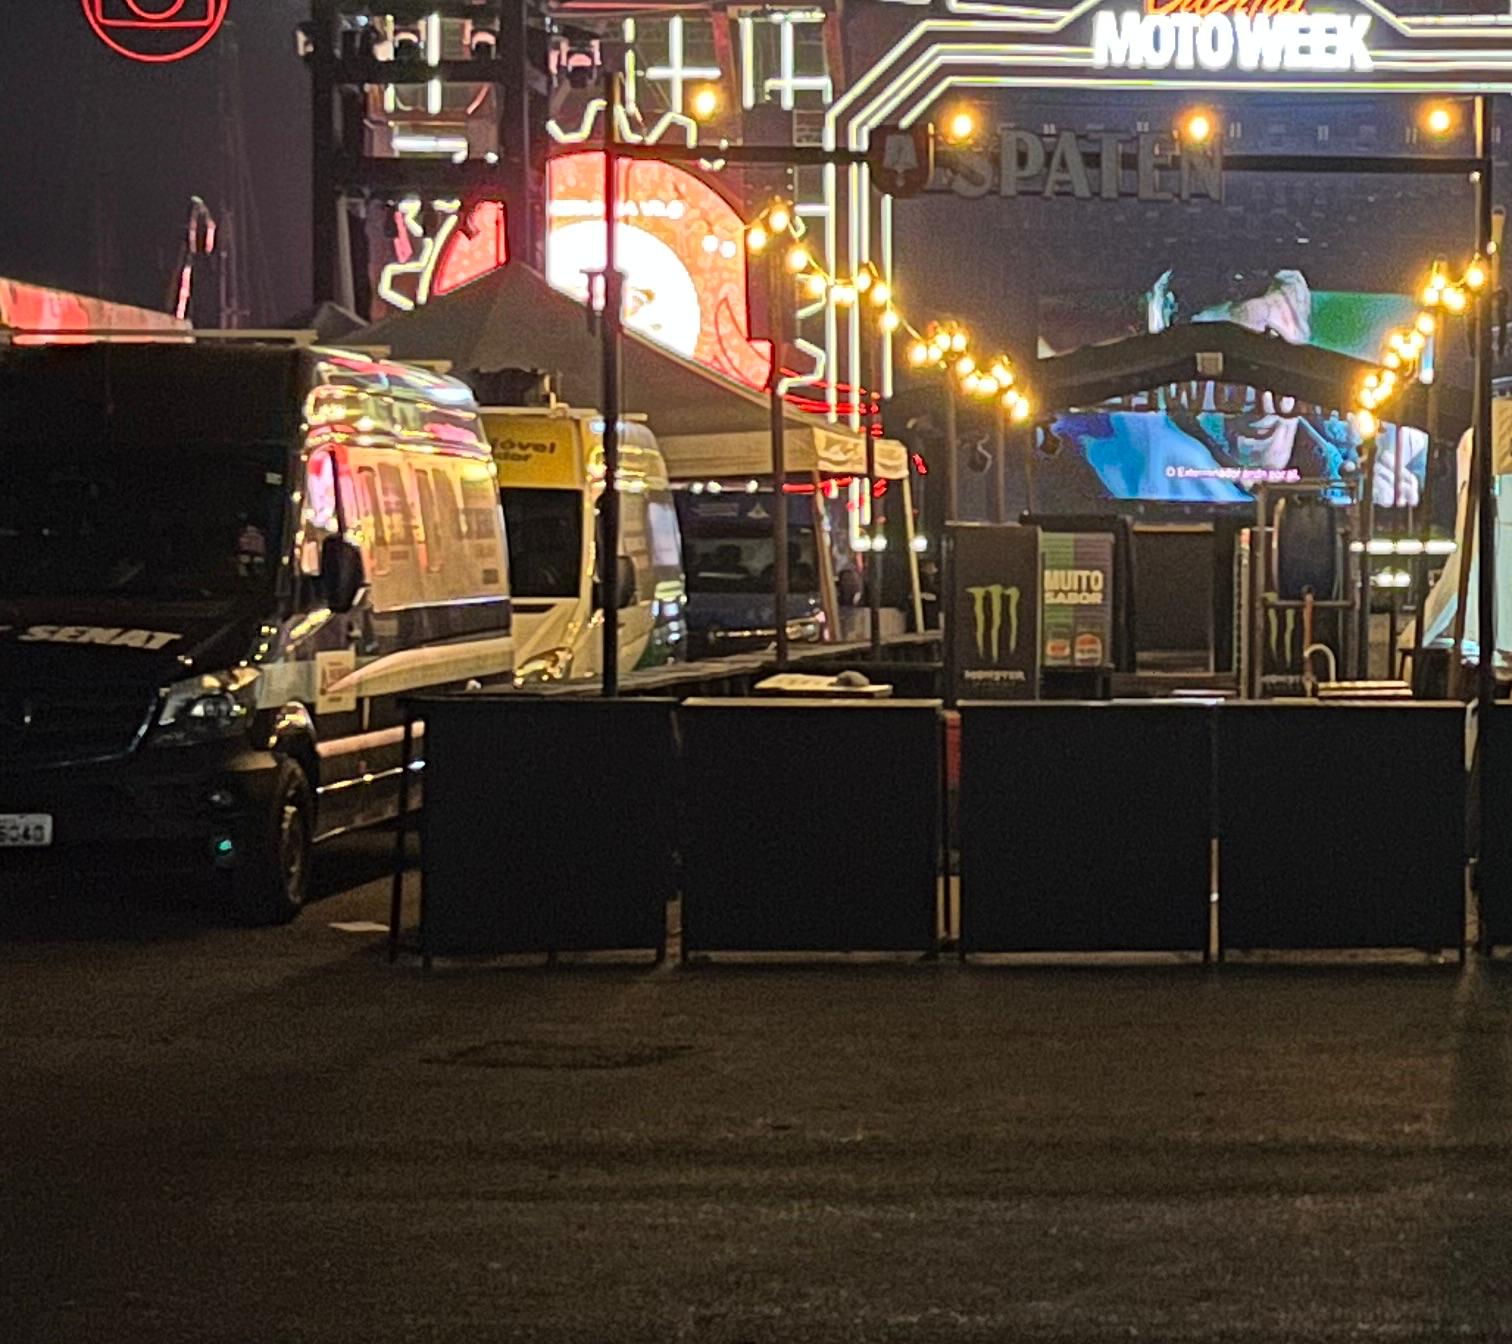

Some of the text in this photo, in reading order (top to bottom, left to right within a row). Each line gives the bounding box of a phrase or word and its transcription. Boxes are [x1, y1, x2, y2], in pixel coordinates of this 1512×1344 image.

[950, 129, 1225, 203] SPATEN
[1044, 570, 1104, 591] MUITO
[1044, 592, 1103, 605] SABOR
[18, 625, 184, 650] SENAT
